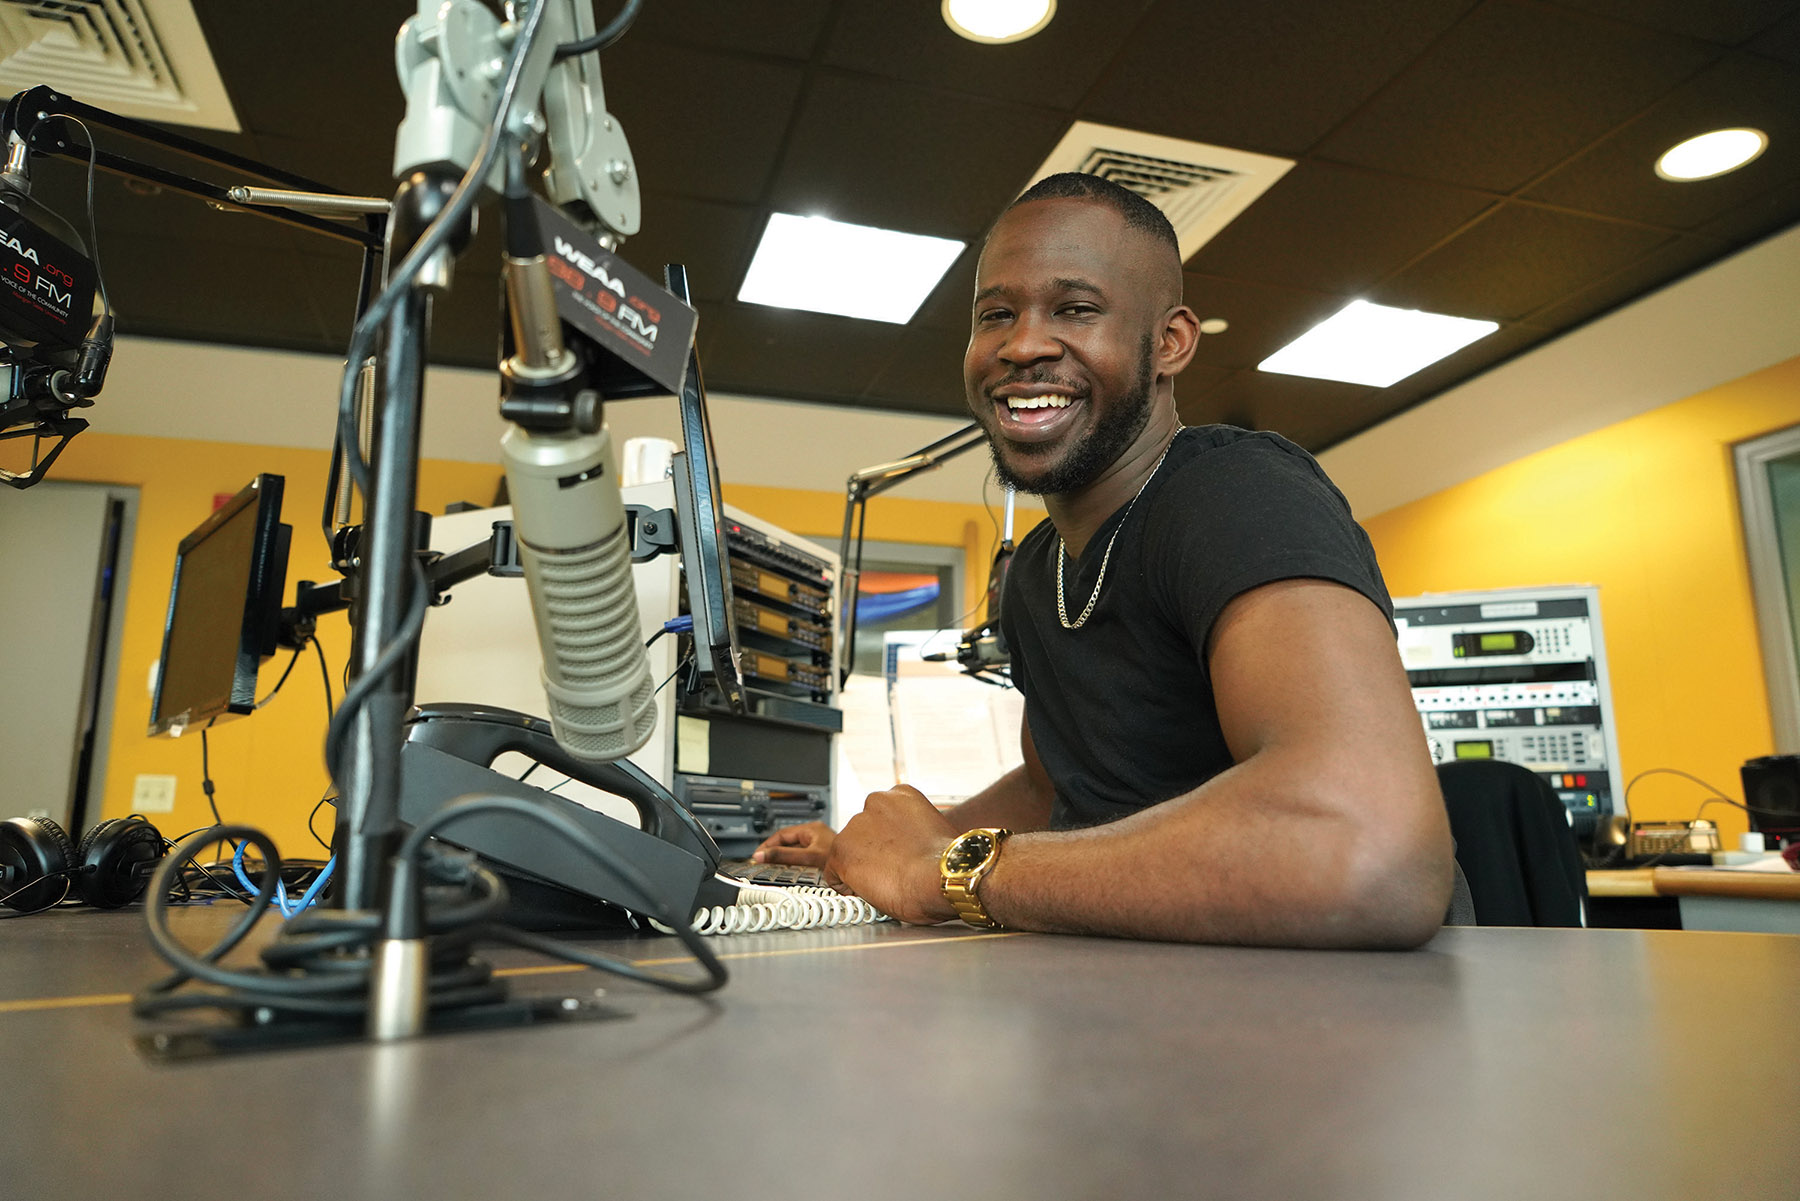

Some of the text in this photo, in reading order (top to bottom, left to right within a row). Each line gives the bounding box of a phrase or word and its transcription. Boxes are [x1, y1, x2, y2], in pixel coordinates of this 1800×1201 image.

[43, 264, 73, 287] .org
[554, 235, 626, 298] WEAA
[0, 275, 69, 318] VOICE OF THE COMMUNITY
[35, 274, 71, 308] FM
[617, 303, 658, 342] FM
